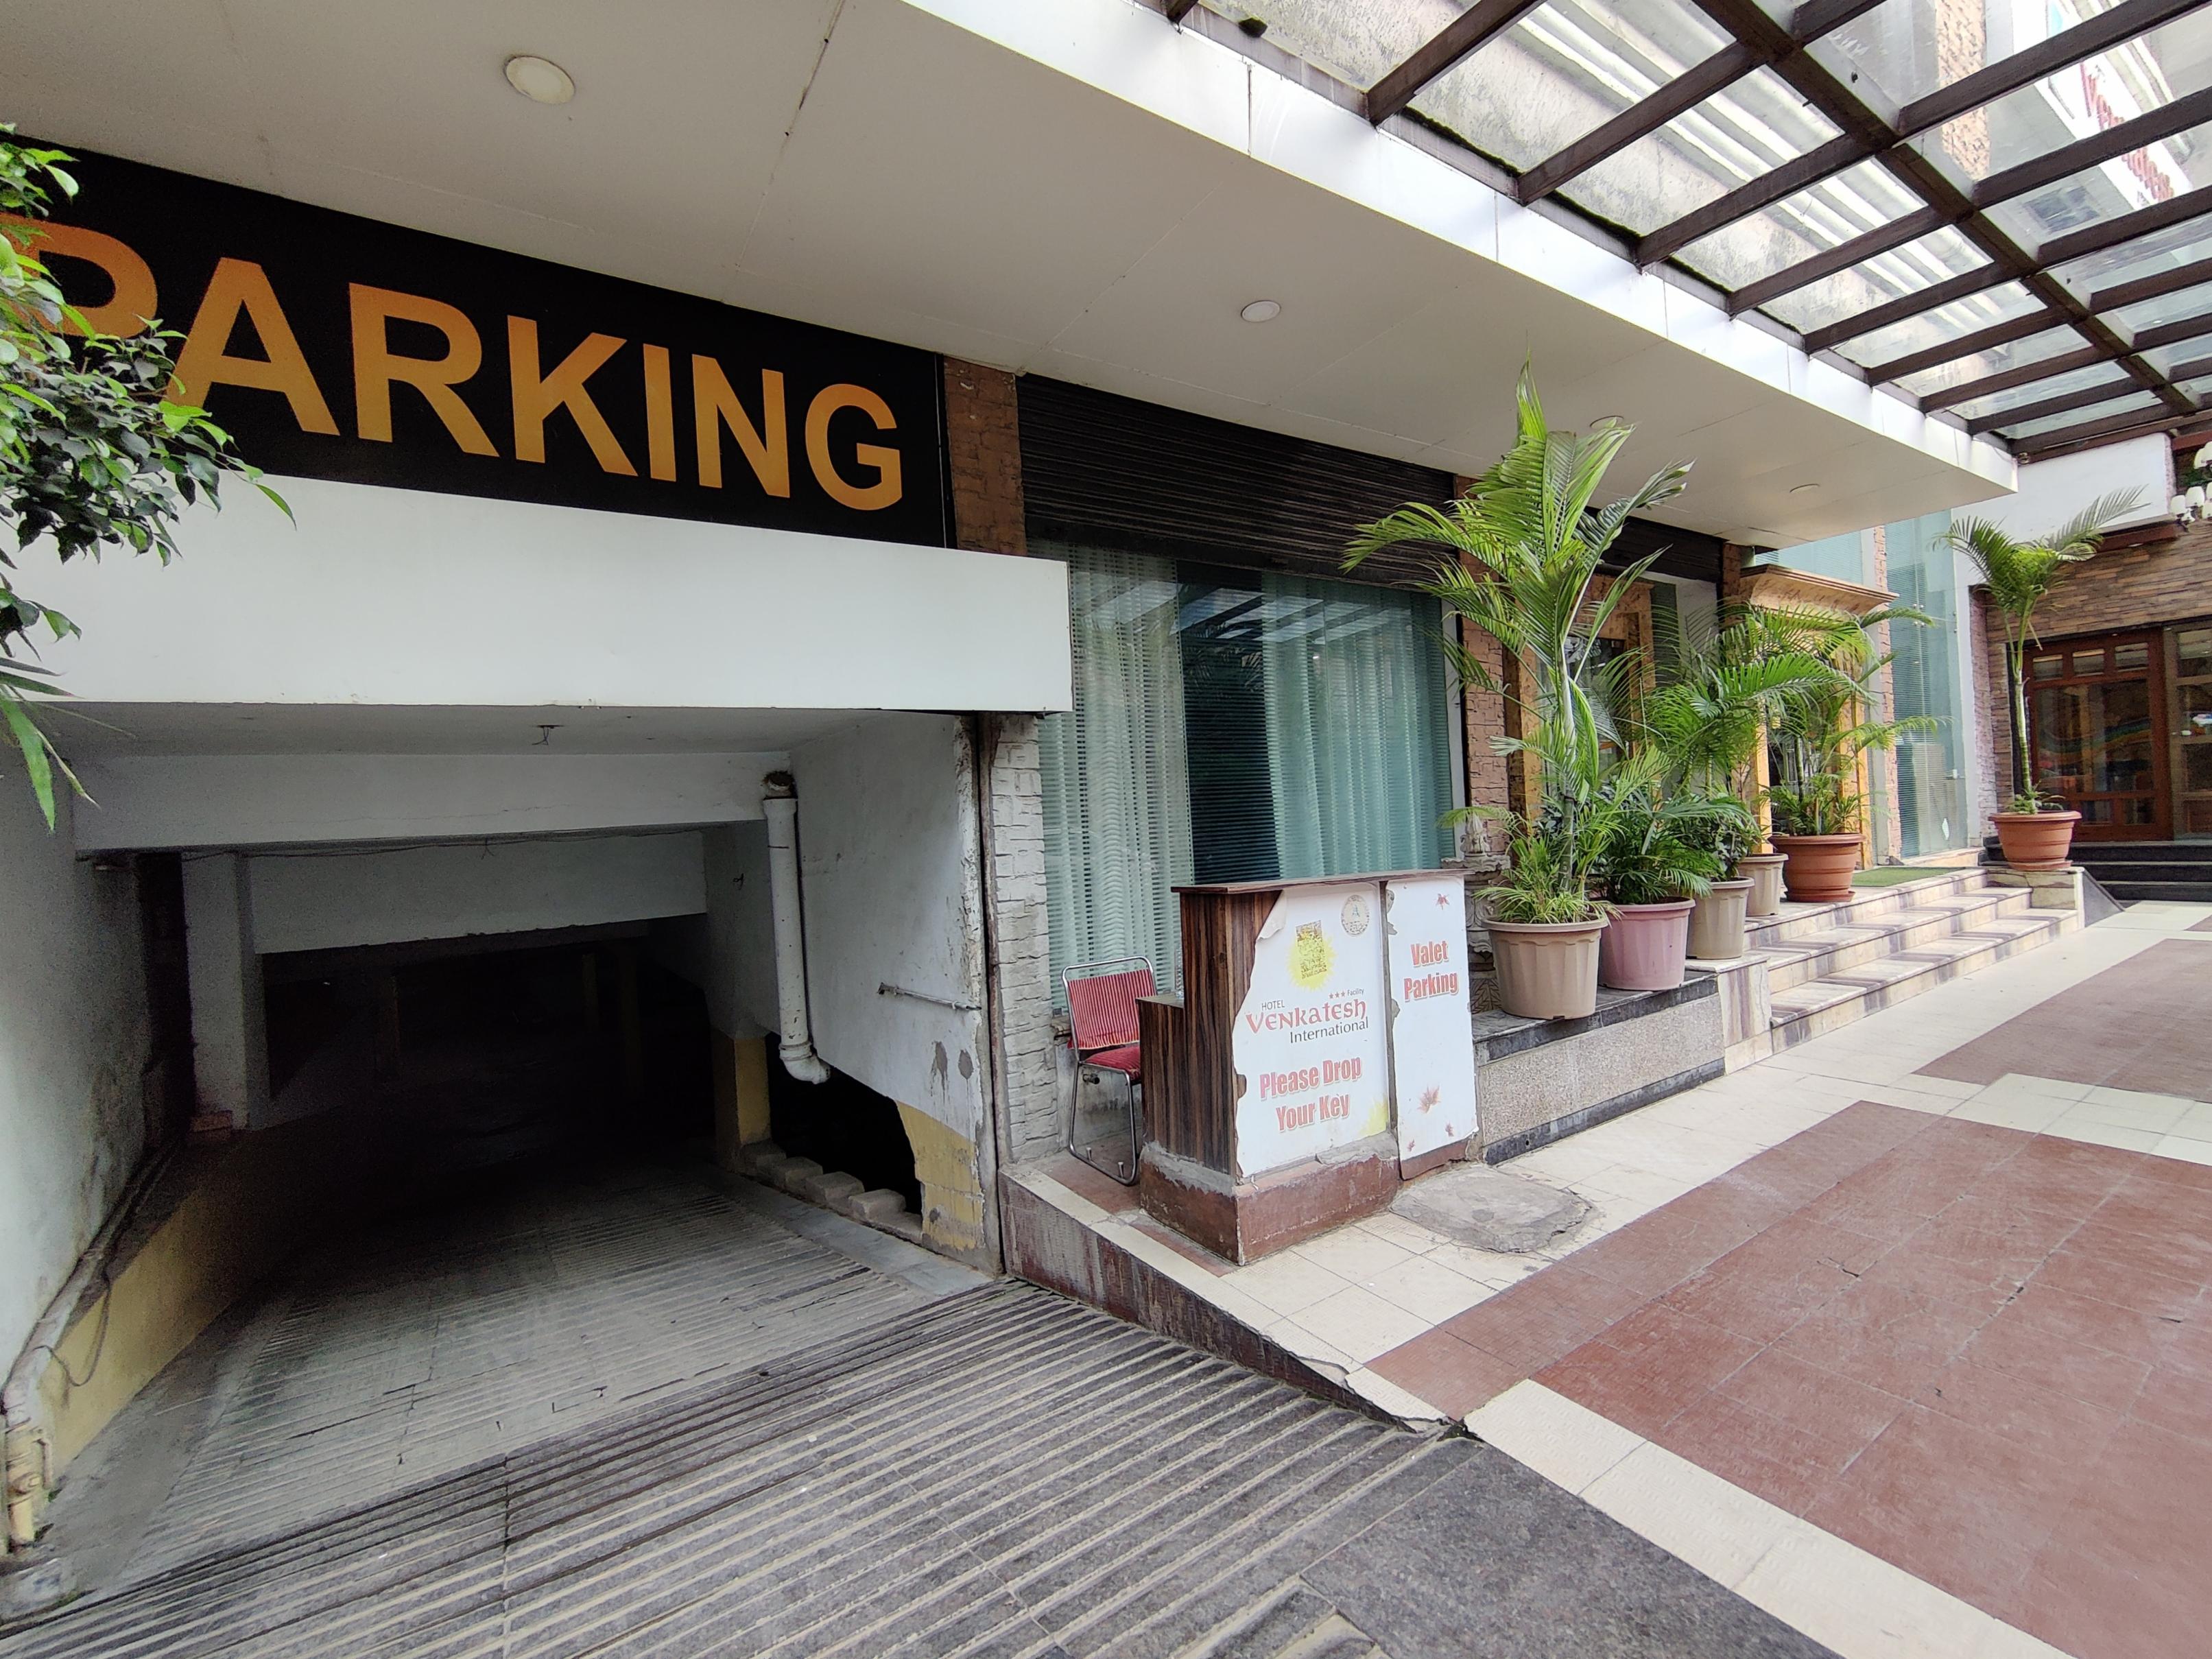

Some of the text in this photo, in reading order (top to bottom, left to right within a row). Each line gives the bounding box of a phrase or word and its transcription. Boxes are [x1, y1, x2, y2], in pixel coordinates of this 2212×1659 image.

[0, 212, 904, 512] PARKING
[1410, 940, 1449, 967] Valet
[1403, 972, 1458, 1001] Parking
[1261, 999, 1285, 1011] HOTEL
[1290, 1016, 1369, 1044] International
[1259, 1057, 1362, 1100] Please Drop
[1275, 1094, 1350, 1132] Your Key
